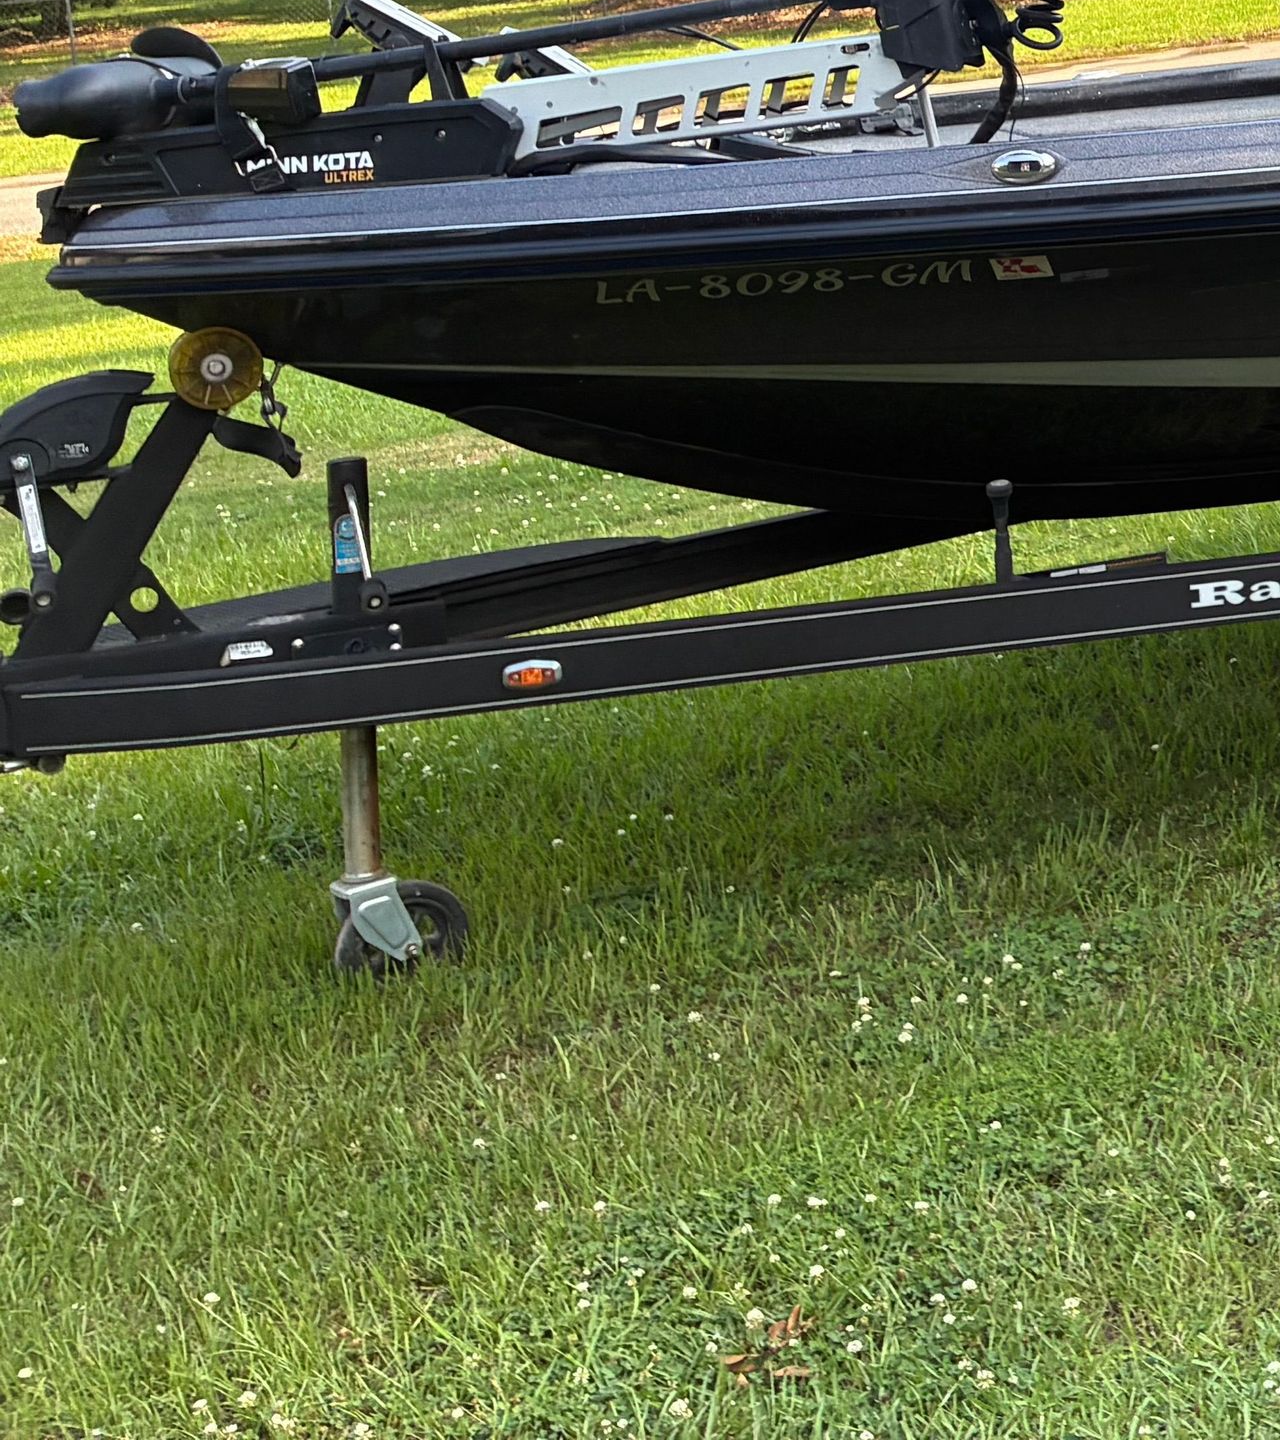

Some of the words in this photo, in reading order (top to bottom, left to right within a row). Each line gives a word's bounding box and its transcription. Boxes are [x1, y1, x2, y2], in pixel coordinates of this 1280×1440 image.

[313, 150, 374, 172] KOTA
[324, 169, 375, 184] ULTREX
[596, 260, 972, 304] LA-8098-GM
